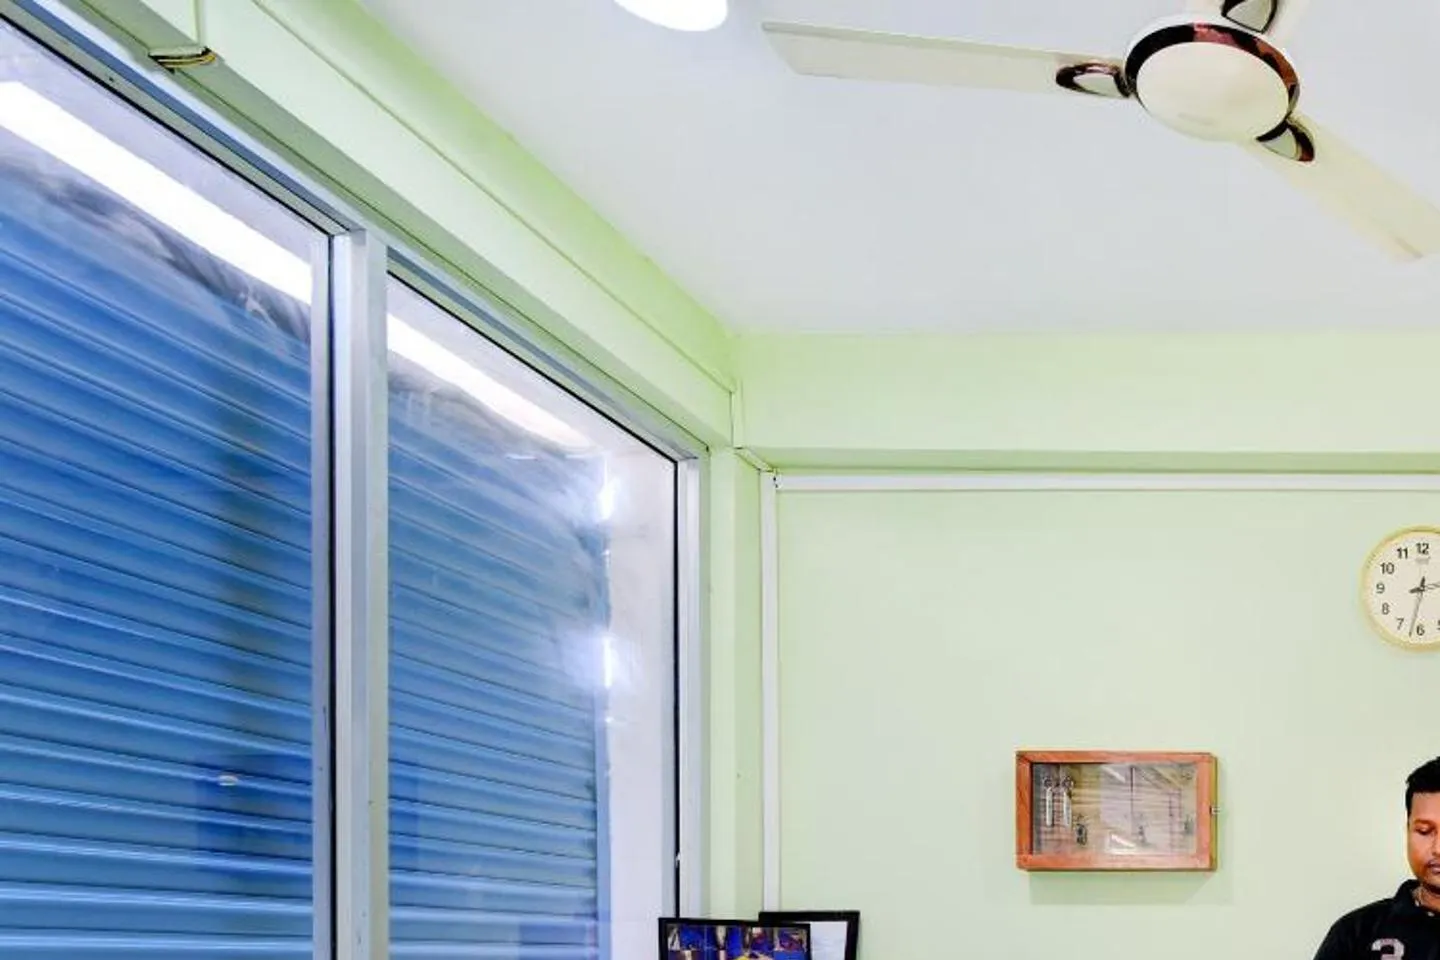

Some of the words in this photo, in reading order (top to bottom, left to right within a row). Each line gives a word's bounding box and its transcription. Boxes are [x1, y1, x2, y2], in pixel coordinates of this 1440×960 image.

[1397, 547, 1409, 559] 11
[1416, 542, 1430, 555] 12
[1380, 562, 1395, 574] 10
[1376, 582, 1385, 594] 9
[1381, 602, 1390, 615] 8
[1396, 617, 1404, 630] 7
[1416, 624, 1425, 636] 6
